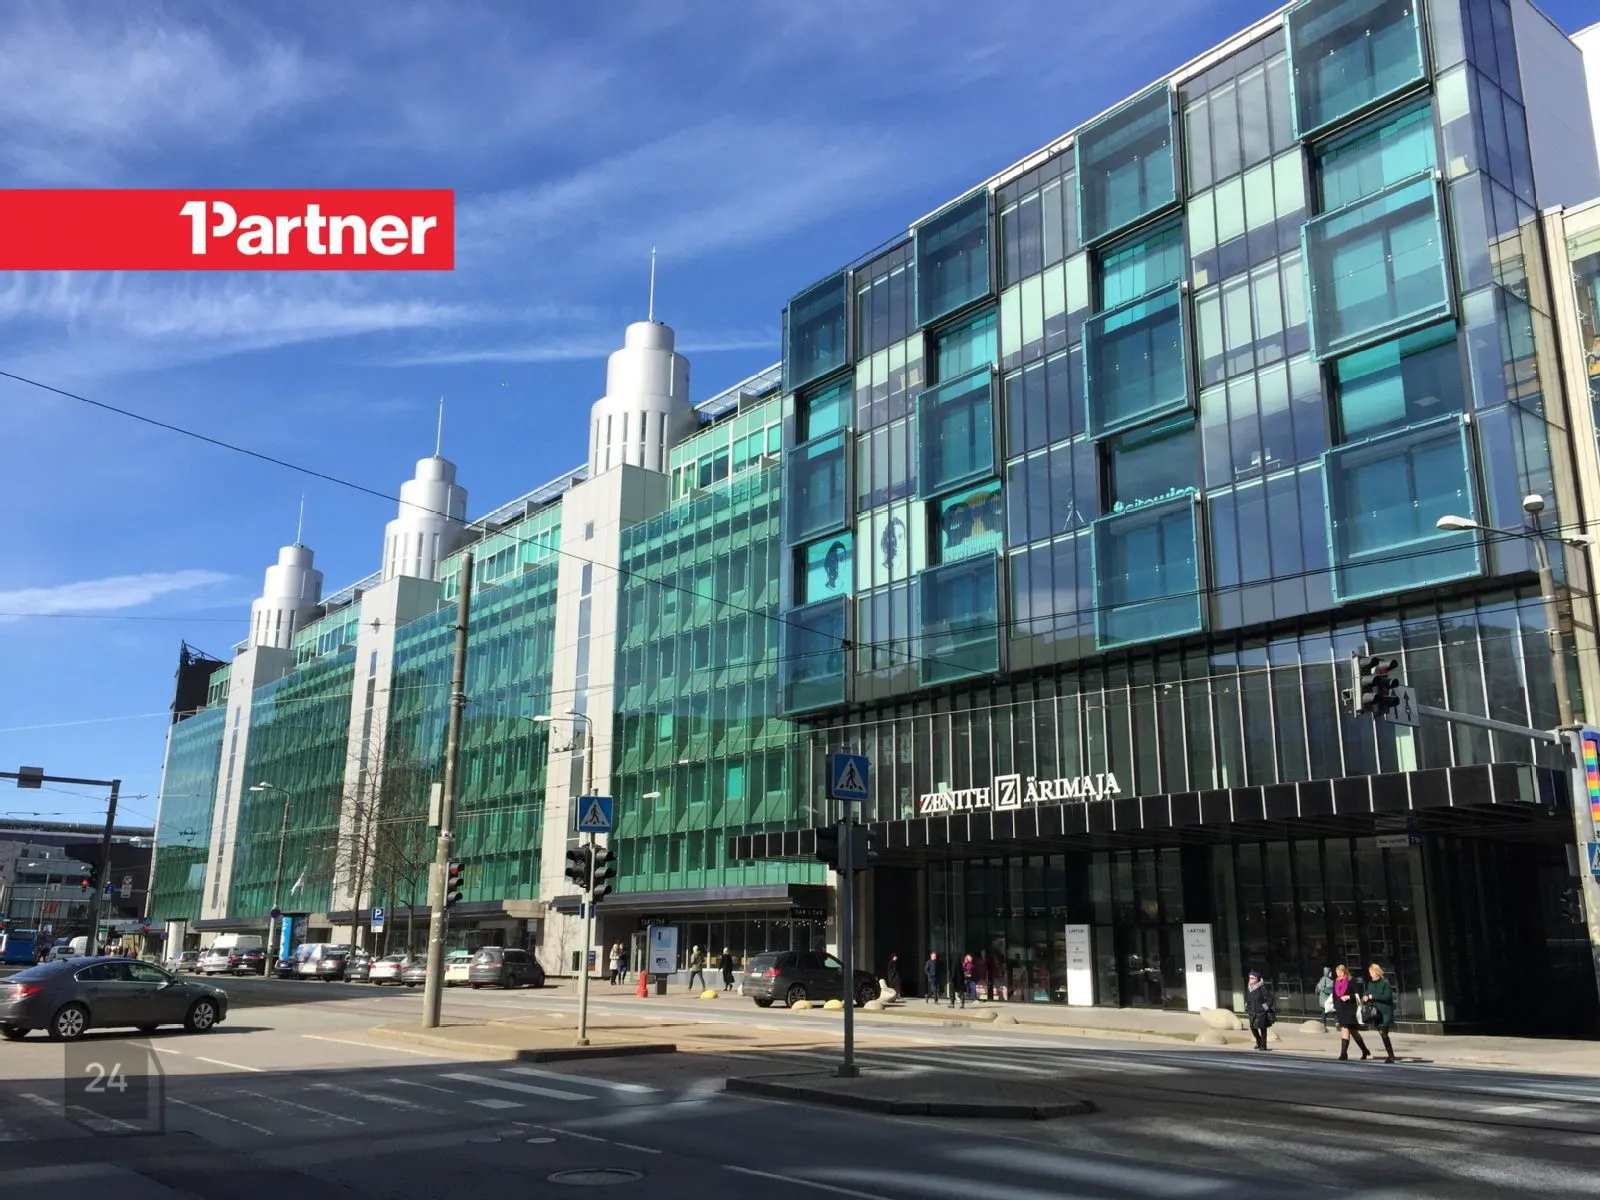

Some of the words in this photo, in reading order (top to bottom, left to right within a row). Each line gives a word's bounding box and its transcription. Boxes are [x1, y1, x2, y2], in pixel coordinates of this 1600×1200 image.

[919, 787, 990, 813] ZENITH
[998, 780, 1018, 808] Z
[1023, 772, 1122, 802] ÄRIMAJA
